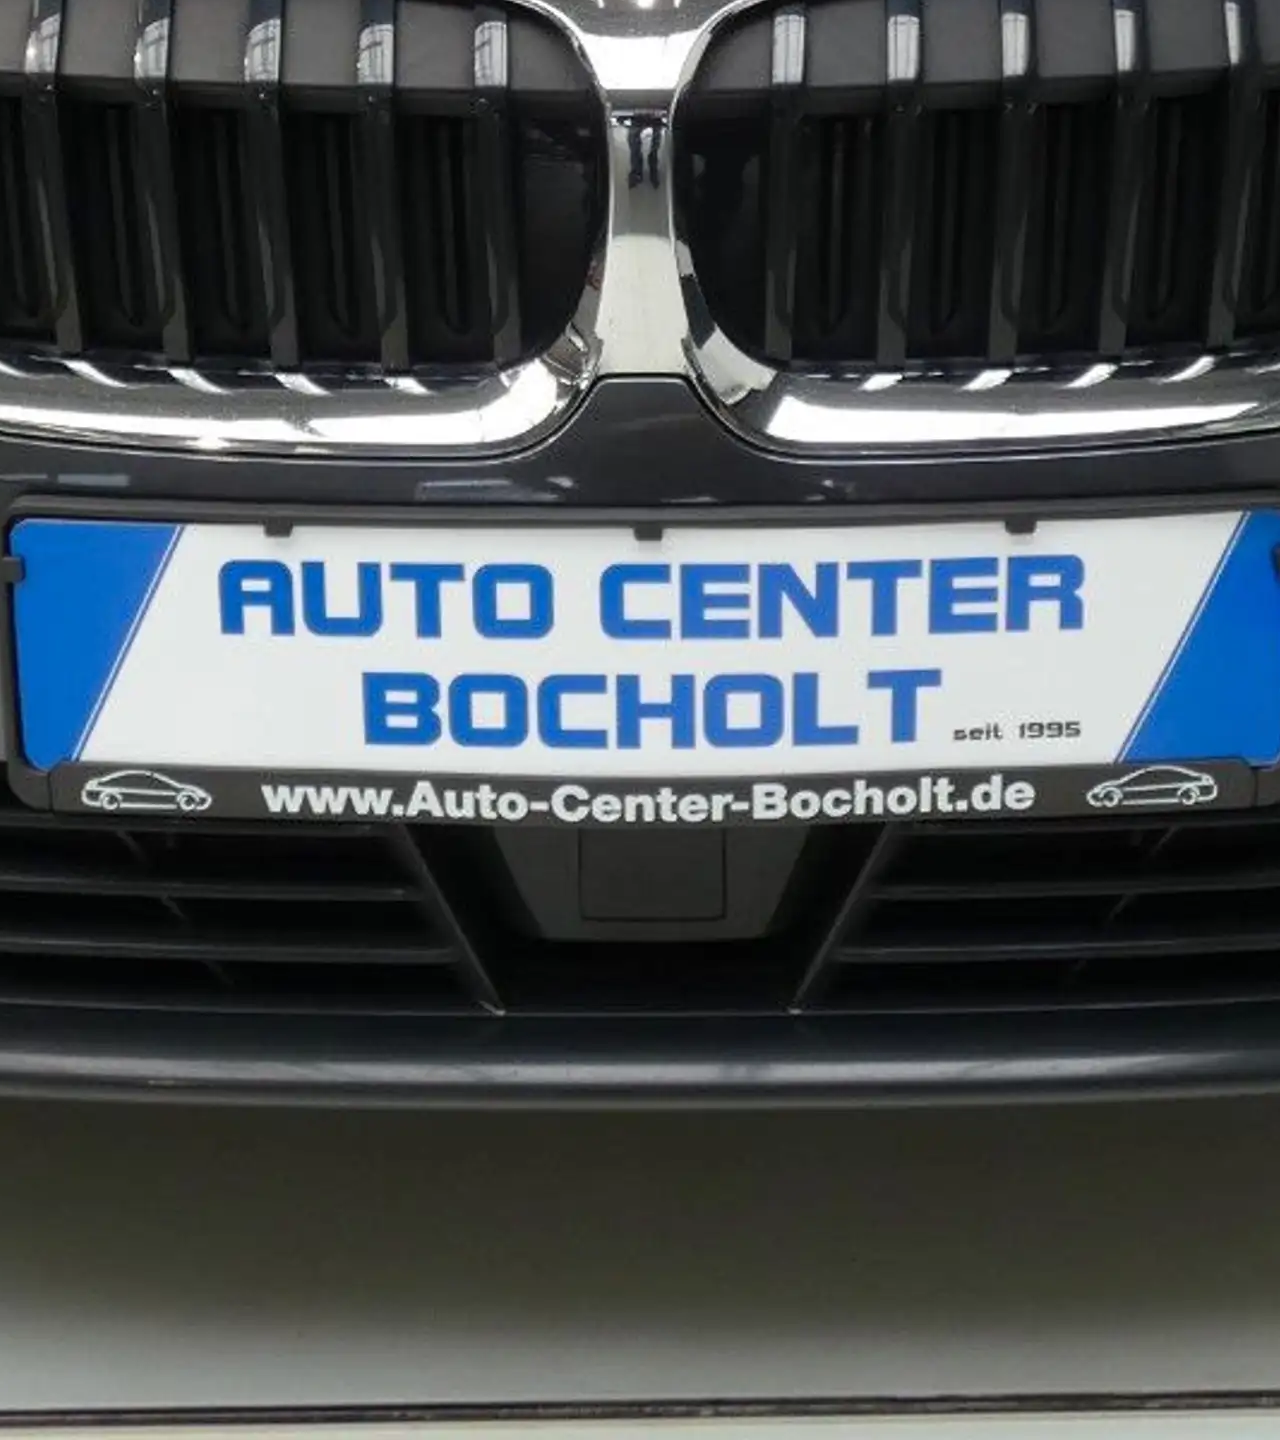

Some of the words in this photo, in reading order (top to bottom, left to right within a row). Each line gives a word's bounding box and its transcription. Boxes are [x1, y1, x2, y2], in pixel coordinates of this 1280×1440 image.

[218, 558, 556, 641] AUTO
[599, 553, 1086, 642] CENTER
[362, 668, 942, 751] BOCHOLT
[953, 723, 1003, 741] seit
[1019, 721, 1081, 739] 1995
[260, 773, 1036, 825] www.Auto-Center-Bocholt.de
